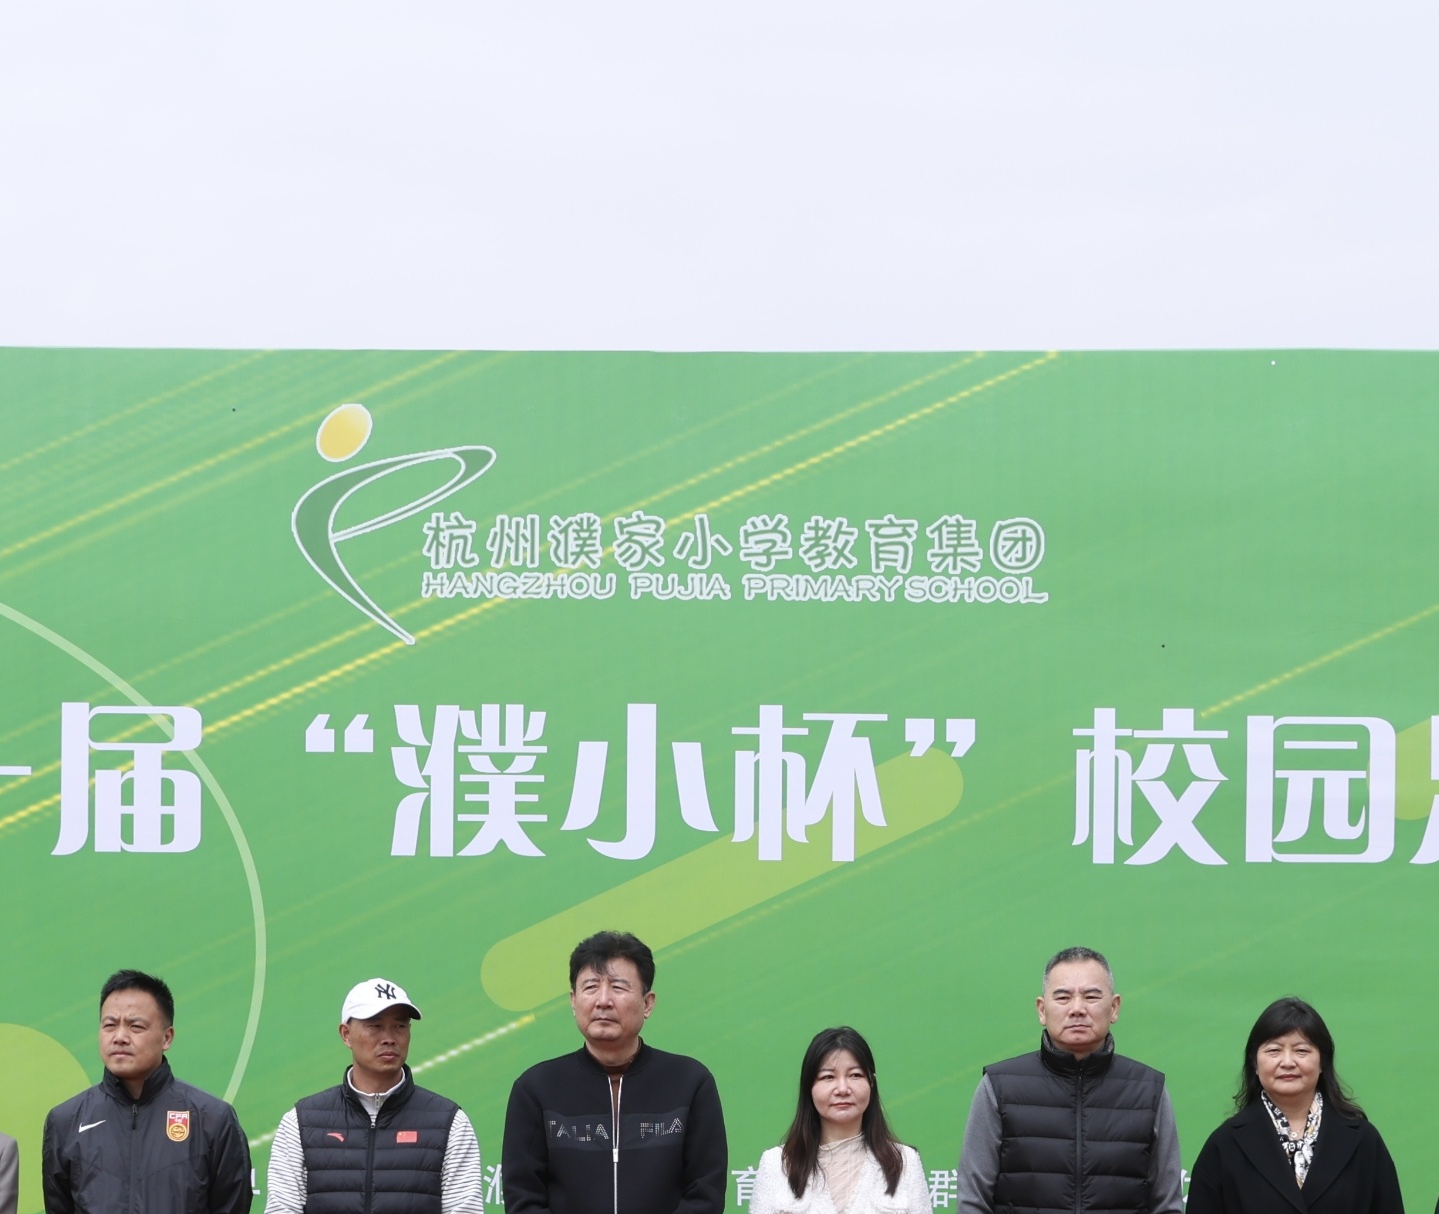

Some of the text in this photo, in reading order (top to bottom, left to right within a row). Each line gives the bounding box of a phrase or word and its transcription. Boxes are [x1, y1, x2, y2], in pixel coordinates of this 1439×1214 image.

[421, 511, 1045, 573] 杭州濮家小学教育集团
[421, 572, 1048, 603] HANGZHOU PUJIA PRIMARY SCHOOL
